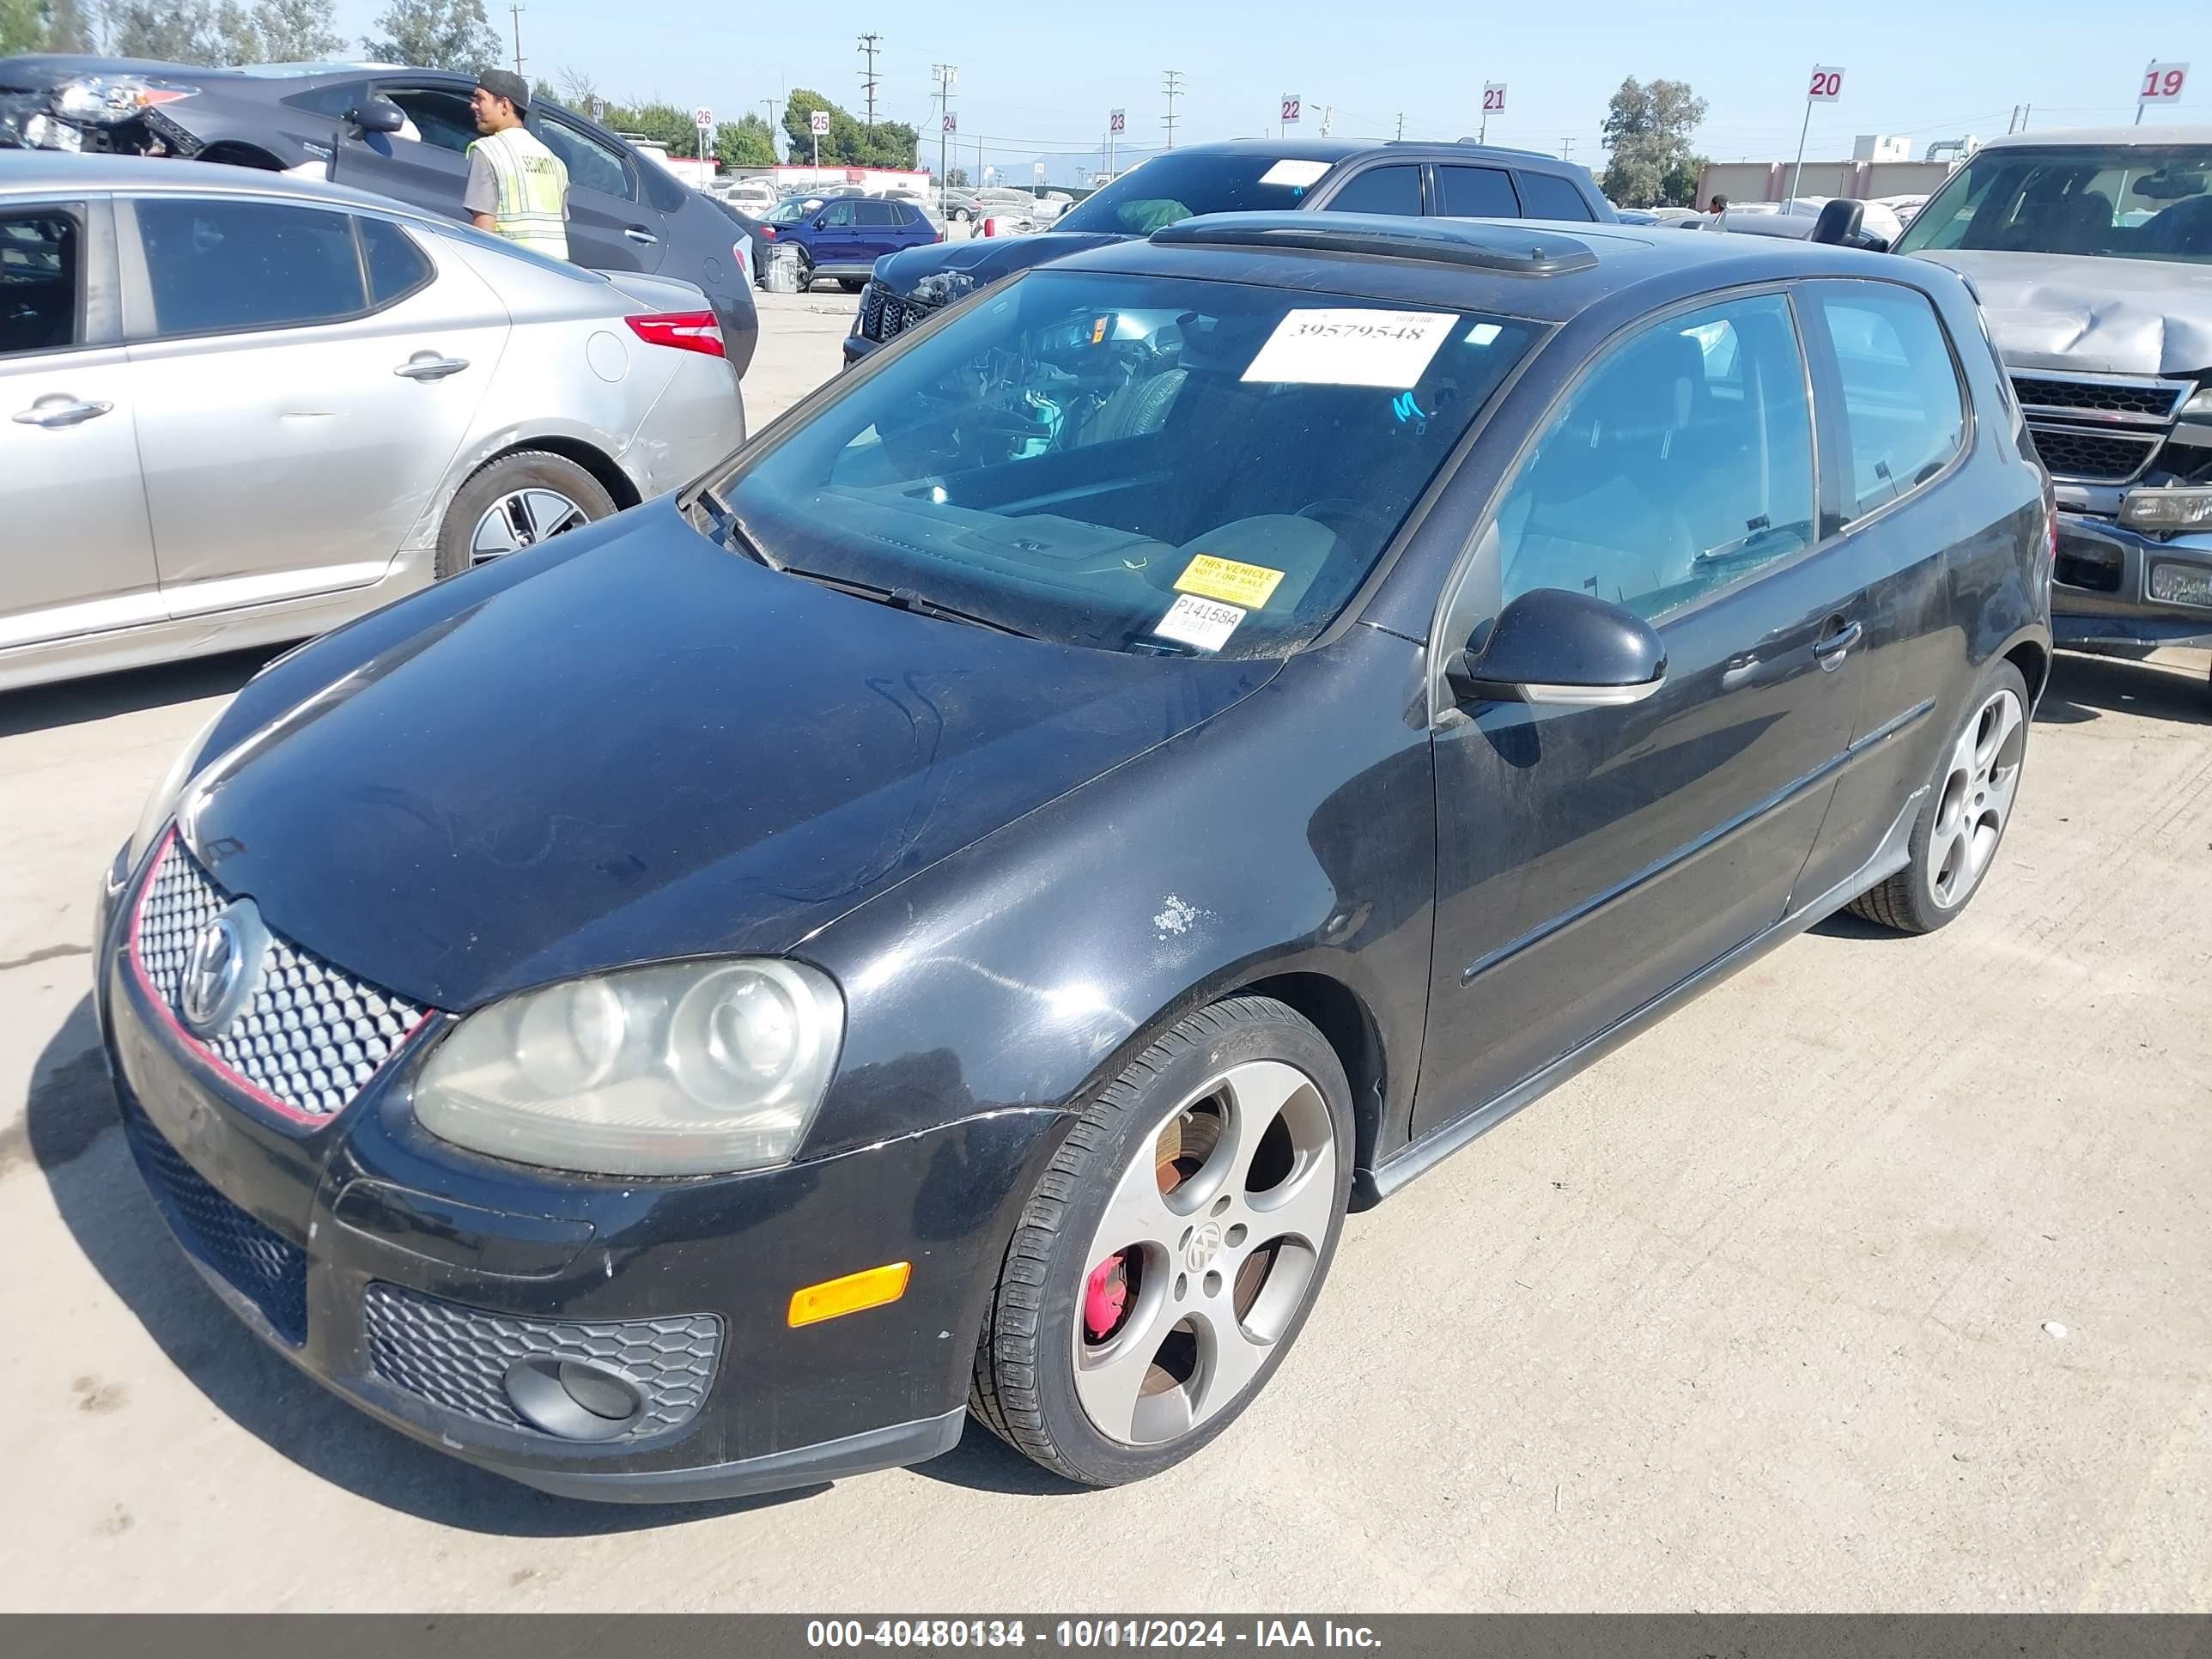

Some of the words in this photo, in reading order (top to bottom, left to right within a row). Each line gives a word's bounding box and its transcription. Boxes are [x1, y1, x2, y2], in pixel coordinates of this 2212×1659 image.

[1810, 73, 1841, 95] 20
[2142, 70, 2184, 96] 19
[1484, 90, 1504, 109] 21
[593, 102, 602, 116] 27
[697, 111, 711, 124] 26
[1283, 100, 1299, 118] 22
[812, 116, 828, 130] 25
[943, 116, 956, 131] 24
[1111, 113, 1125, 131] 23
[522, 155, 563, 176] SECURITY
[1290, 324, 1425, 340] 39579548
[1193, 568, 1214, 577] NOT
[1215, 571, 1237, 580] FOR
[1238, 577, 1266, 587] SALE
[1197, 557, 1223, 568] THIS
[1225, 564, 1276, 580] VEHICLE
[1174, 599, 1239, 626] P14158A
